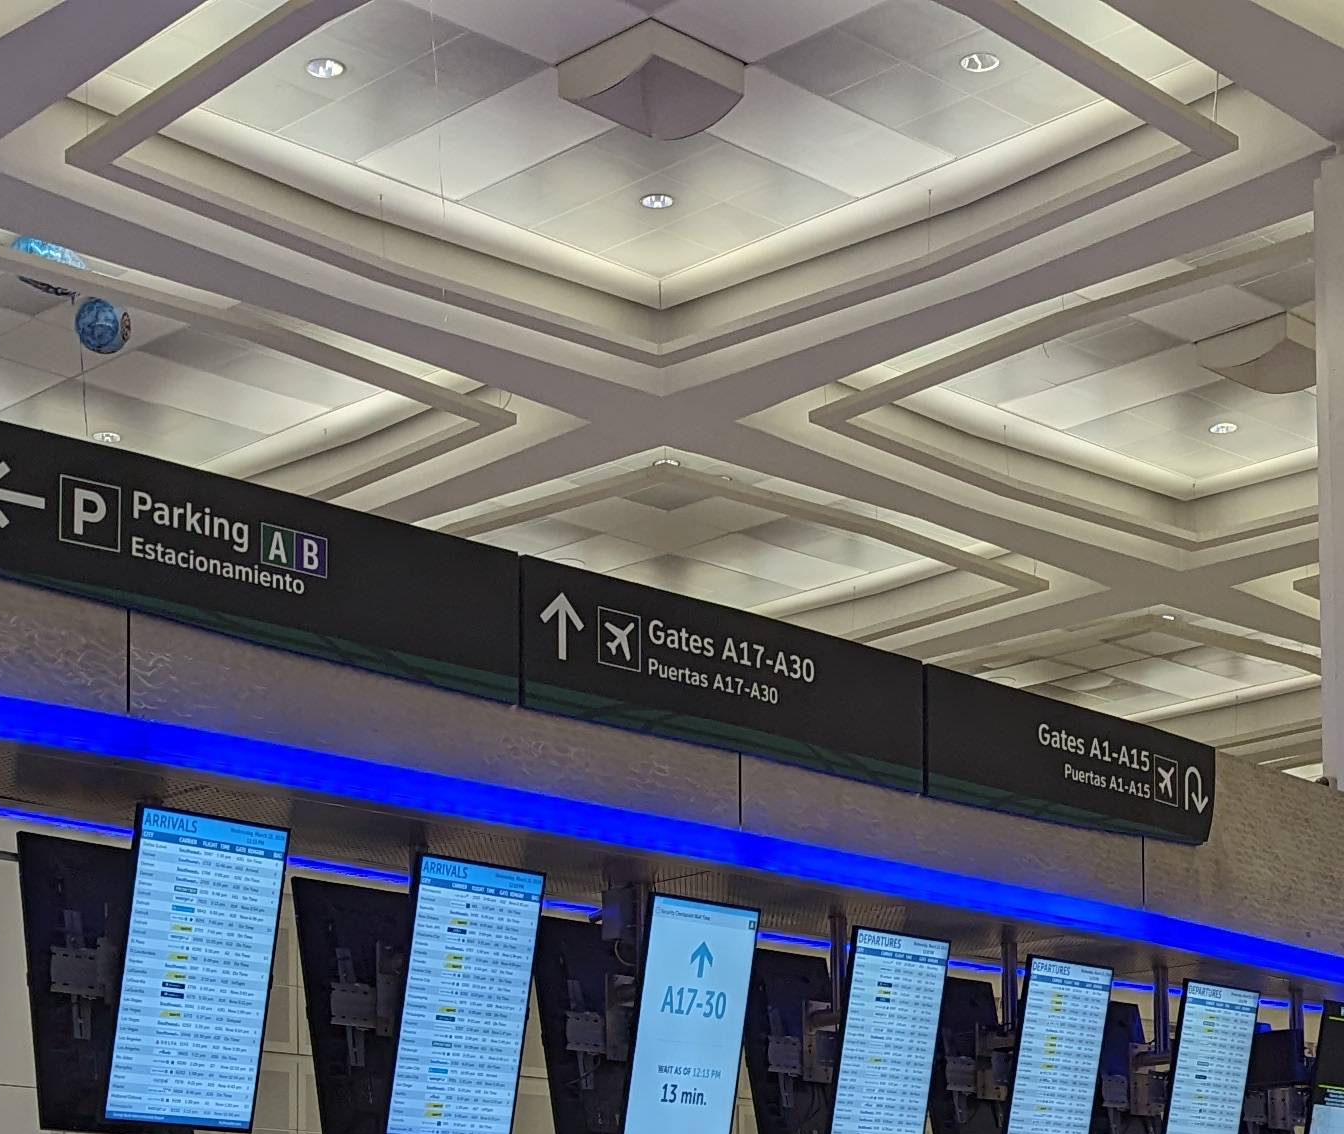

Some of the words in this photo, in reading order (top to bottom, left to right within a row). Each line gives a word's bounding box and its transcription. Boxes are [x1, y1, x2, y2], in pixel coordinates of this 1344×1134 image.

[72, 487, 107, 535] P
[132, 493, 249, 552] Parking
[268, 531, 287, 564] A
[303, 539, 320, 570] B
[132, 536, 306, 596] Estacionamiento
[648, 620, 715, 658] Gates
[722, 635, 815, 683] A17-A30
[648, 658, 708, 690] Puertas
[713, 672, 779, 705] A17-A30
[1038, 724, 1085, 756] Gates
[1089, 736, 1150, 773] A1-A15
[1064, 764, 1106, 790] Puertas
[1109, 774, 1151, 799] A1-A15
[144, 812, 198, 833] ARRIVALS
[423, 861, 468, 879] ARRIVALS
[858, 933, 901, 949] DEPARTURES
[1033, 961, 1070, 976] DEPARTURES
[660, 985, 727, 1020] A17-30
[1188, 985, 1223, 999] DEPARTURES
[674, 1067, 682, 1075] AS
[661, 1083, 677, 1103] 13
[681, 1088, 706, 1105] min.
